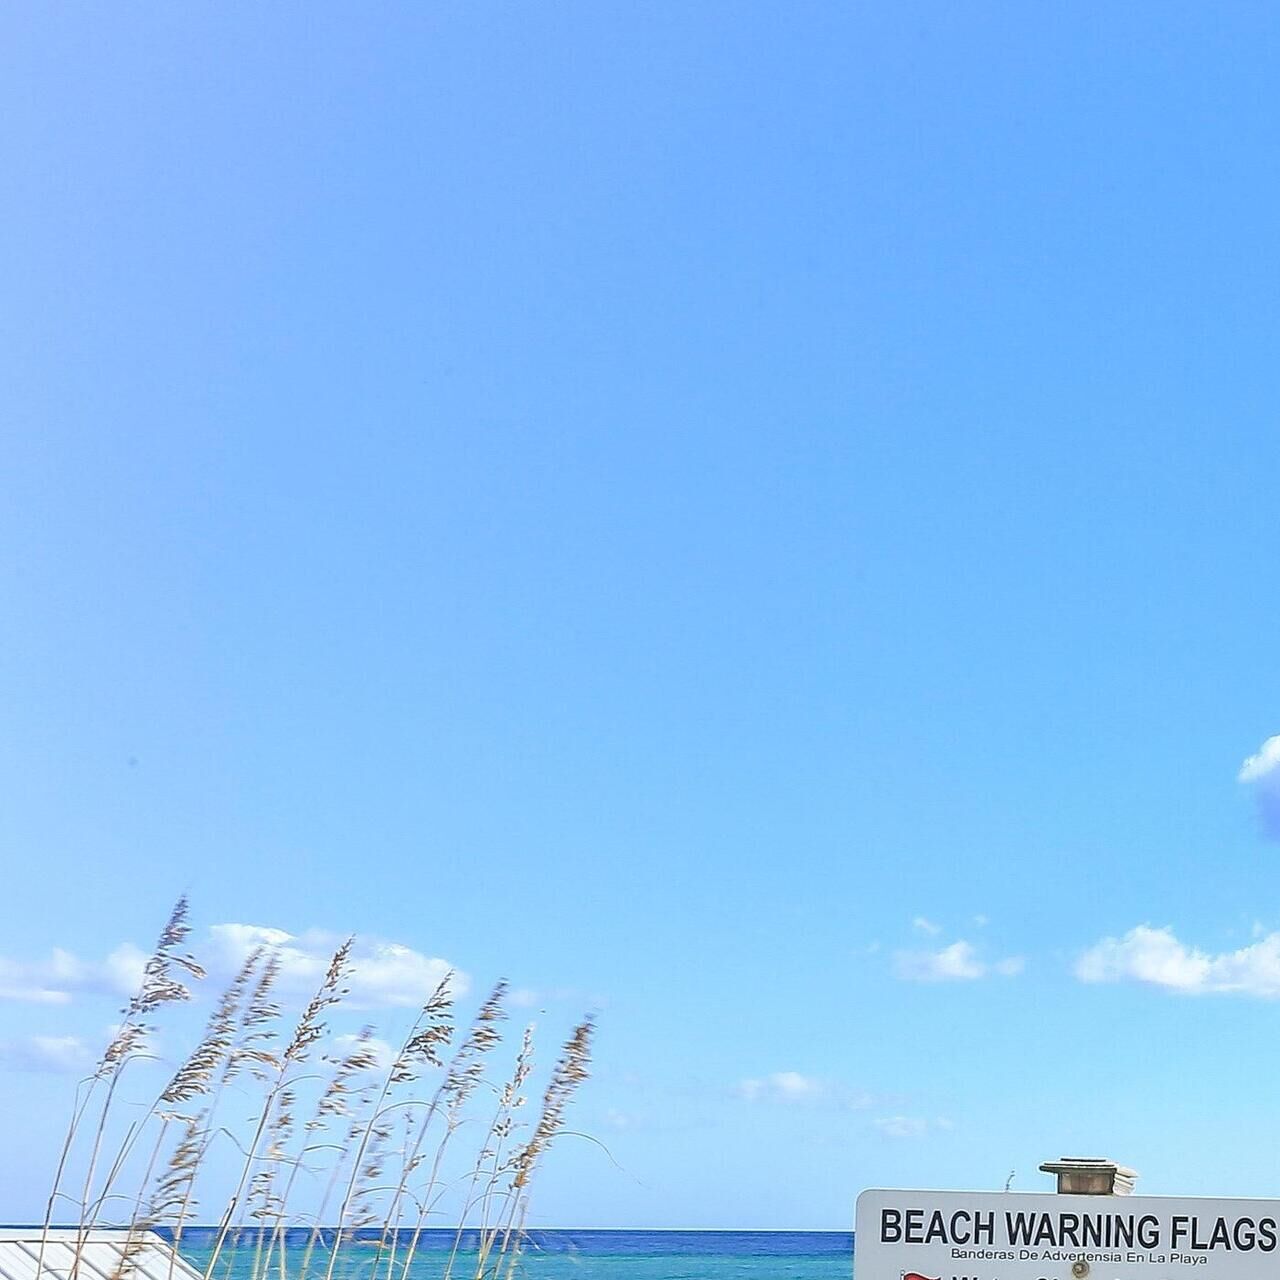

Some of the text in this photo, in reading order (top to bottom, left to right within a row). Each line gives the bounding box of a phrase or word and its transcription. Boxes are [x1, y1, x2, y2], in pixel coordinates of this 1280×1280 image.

[881, 1210, 1276, 1251] BEACH WARNING FLAGS
[952, 1249, 1014, 1259] Banderas
[1020, 1250, 1038, 1260] De
[1127, 1252, 1144, 1262] En
[1150, 1253, 1165, 1262] La
[1171, 1254, 1207, 1265] Playa
